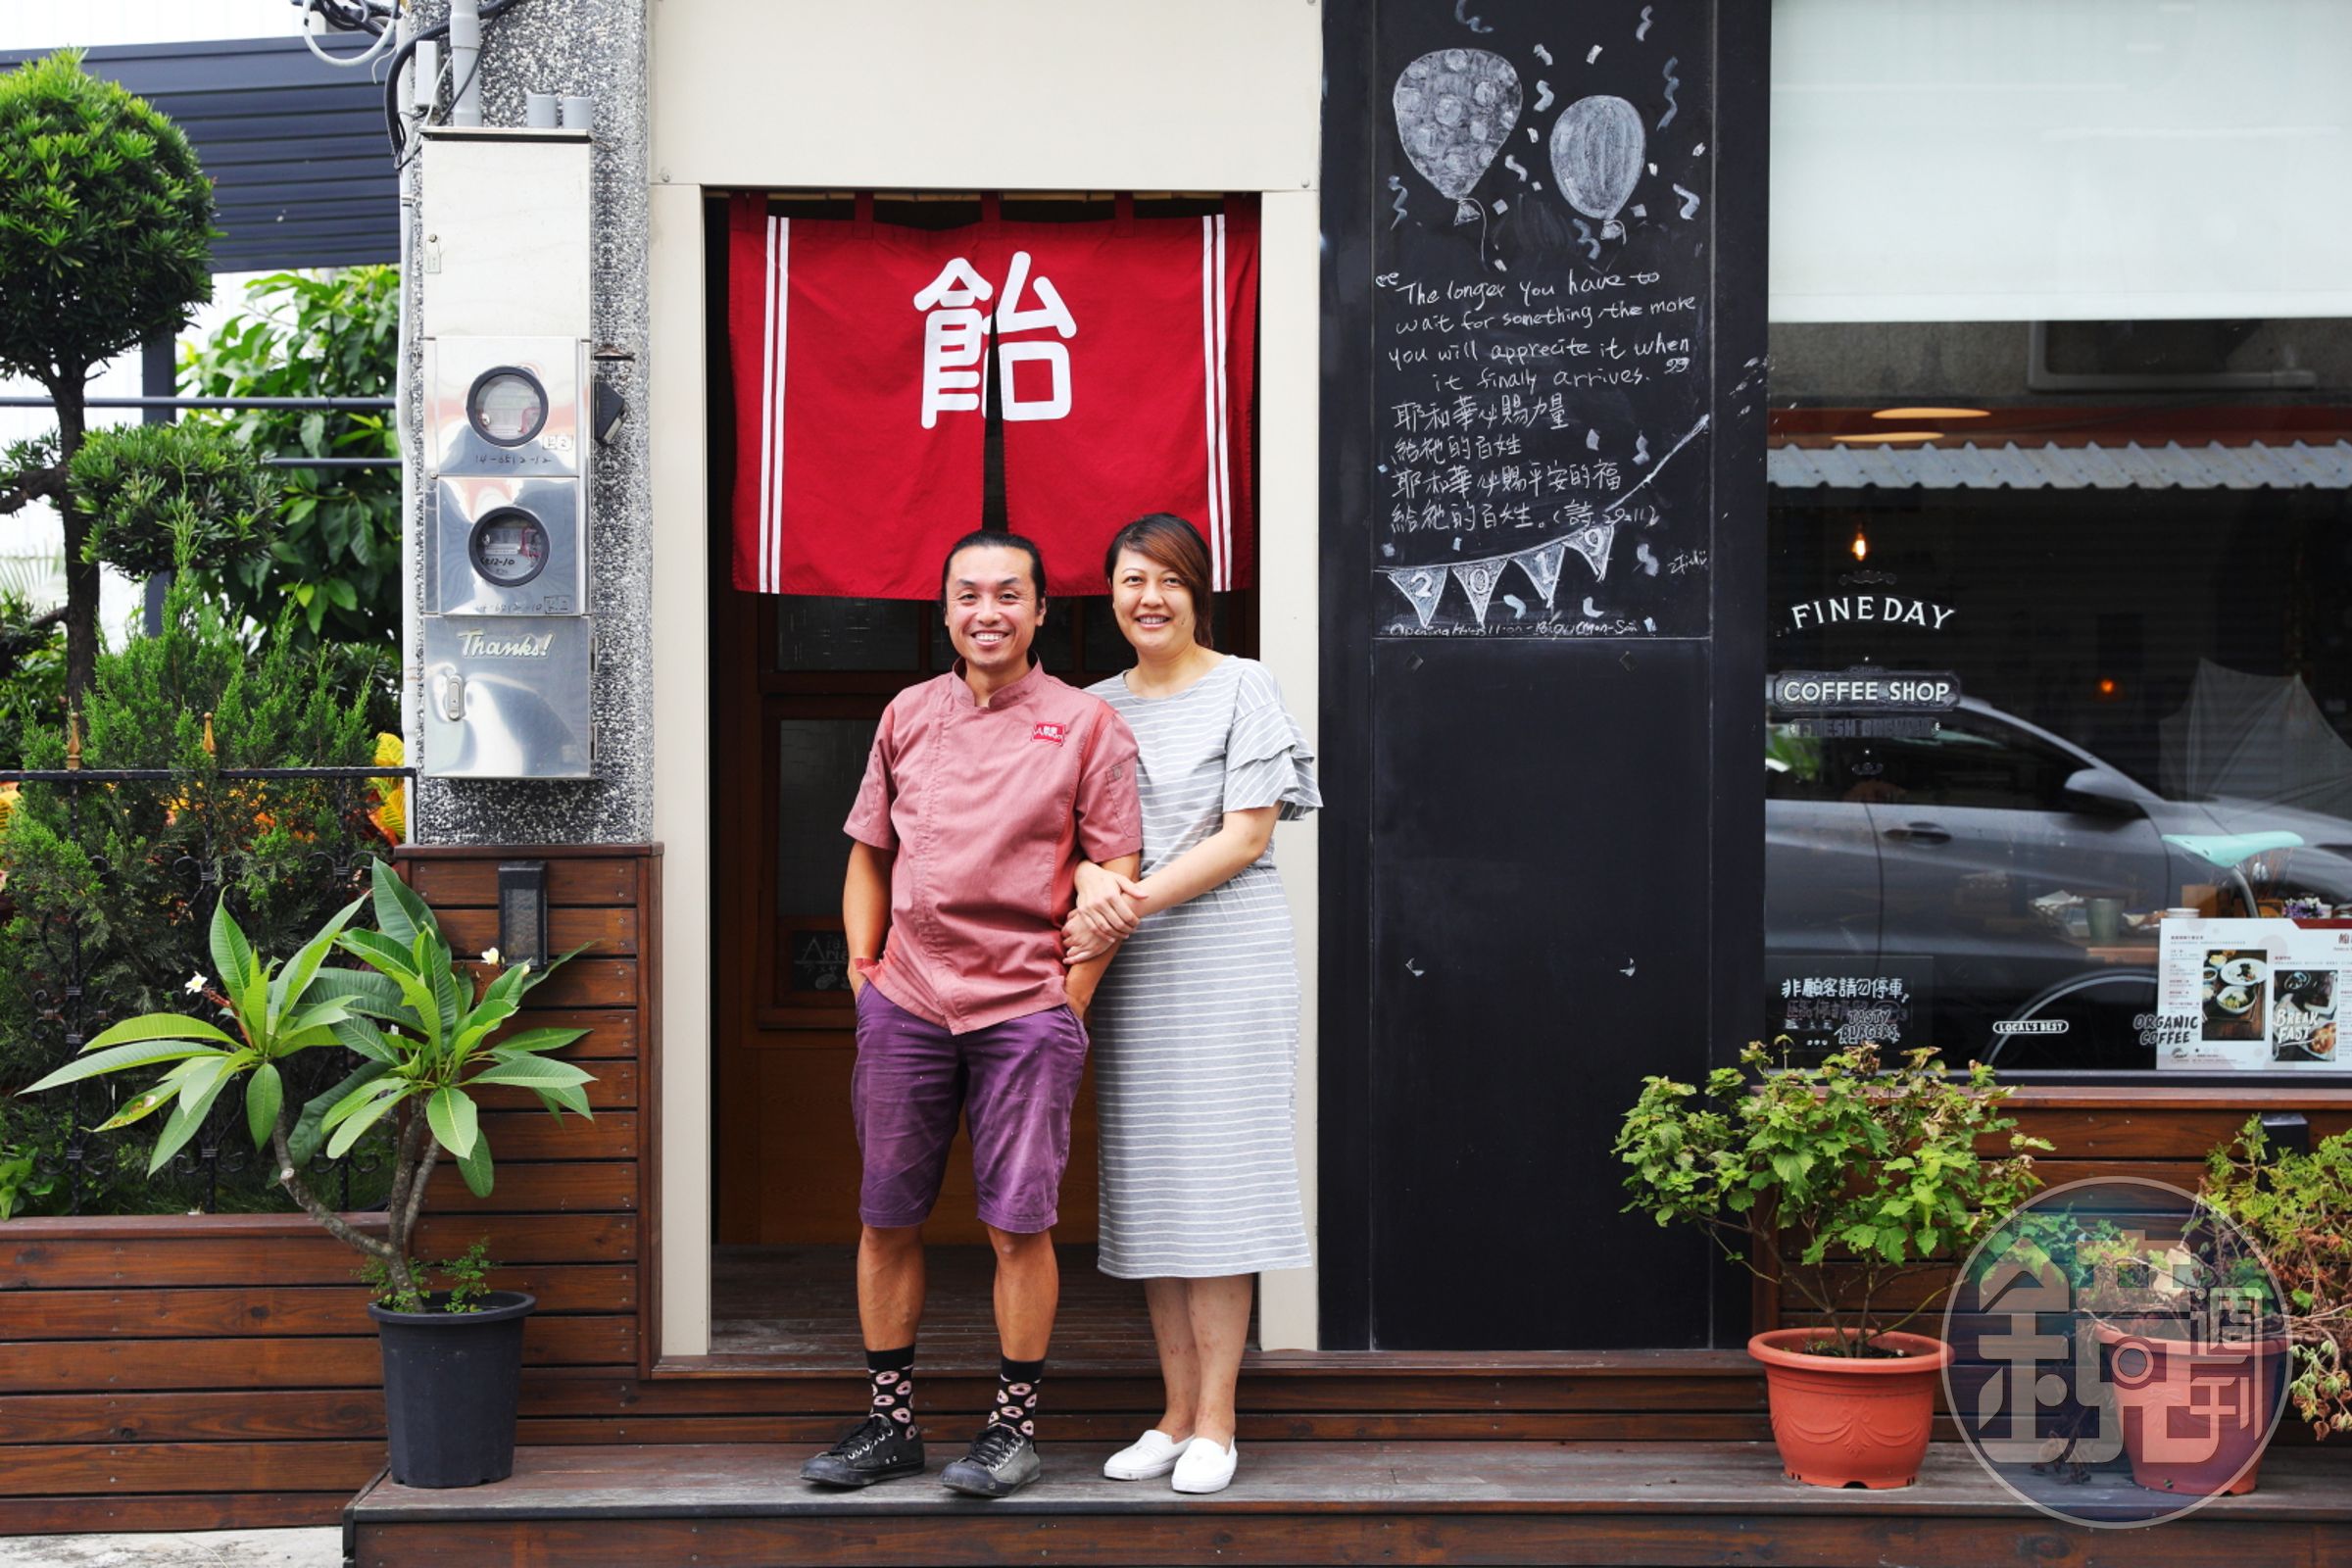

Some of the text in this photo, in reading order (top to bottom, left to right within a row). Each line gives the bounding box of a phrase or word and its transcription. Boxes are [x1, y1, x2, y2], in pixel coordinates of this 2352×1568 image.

[1446, 278, 1504, 311] longer
[1568, 269, 1626, 295] have
[1629, 270, 1661, 285] to
[1396, 296, 1696, 335] wait for something the more
[913, 251, 1077, 429] 飴
[1388, 348, 1429, 370] you
[1438, 341, 1478, 362] will
[1599, 337, 1626, 360] it
[1634, 332, 1690, 355] when
[1433, 368, 1464, 391] it
[1477, 368, 1537, 395] finally
[1391, 393, 1569, 431] 耶和華必賜力量
[1391, 461, 1622, 499] 耶和華必賜平安的福
[457, 628, 555, 657] Thanks!
[1784, 681, 1950, 702] COFFEE SHOP
[1848, 1009, 1891, 1024] TASTY
[1999, 1021, 2063, 1032] LOCAL'S BEST
[2132, 1014, 2198, 1030] ORGANIC
[2140, 1030, 2190, 1046] COFFEE
